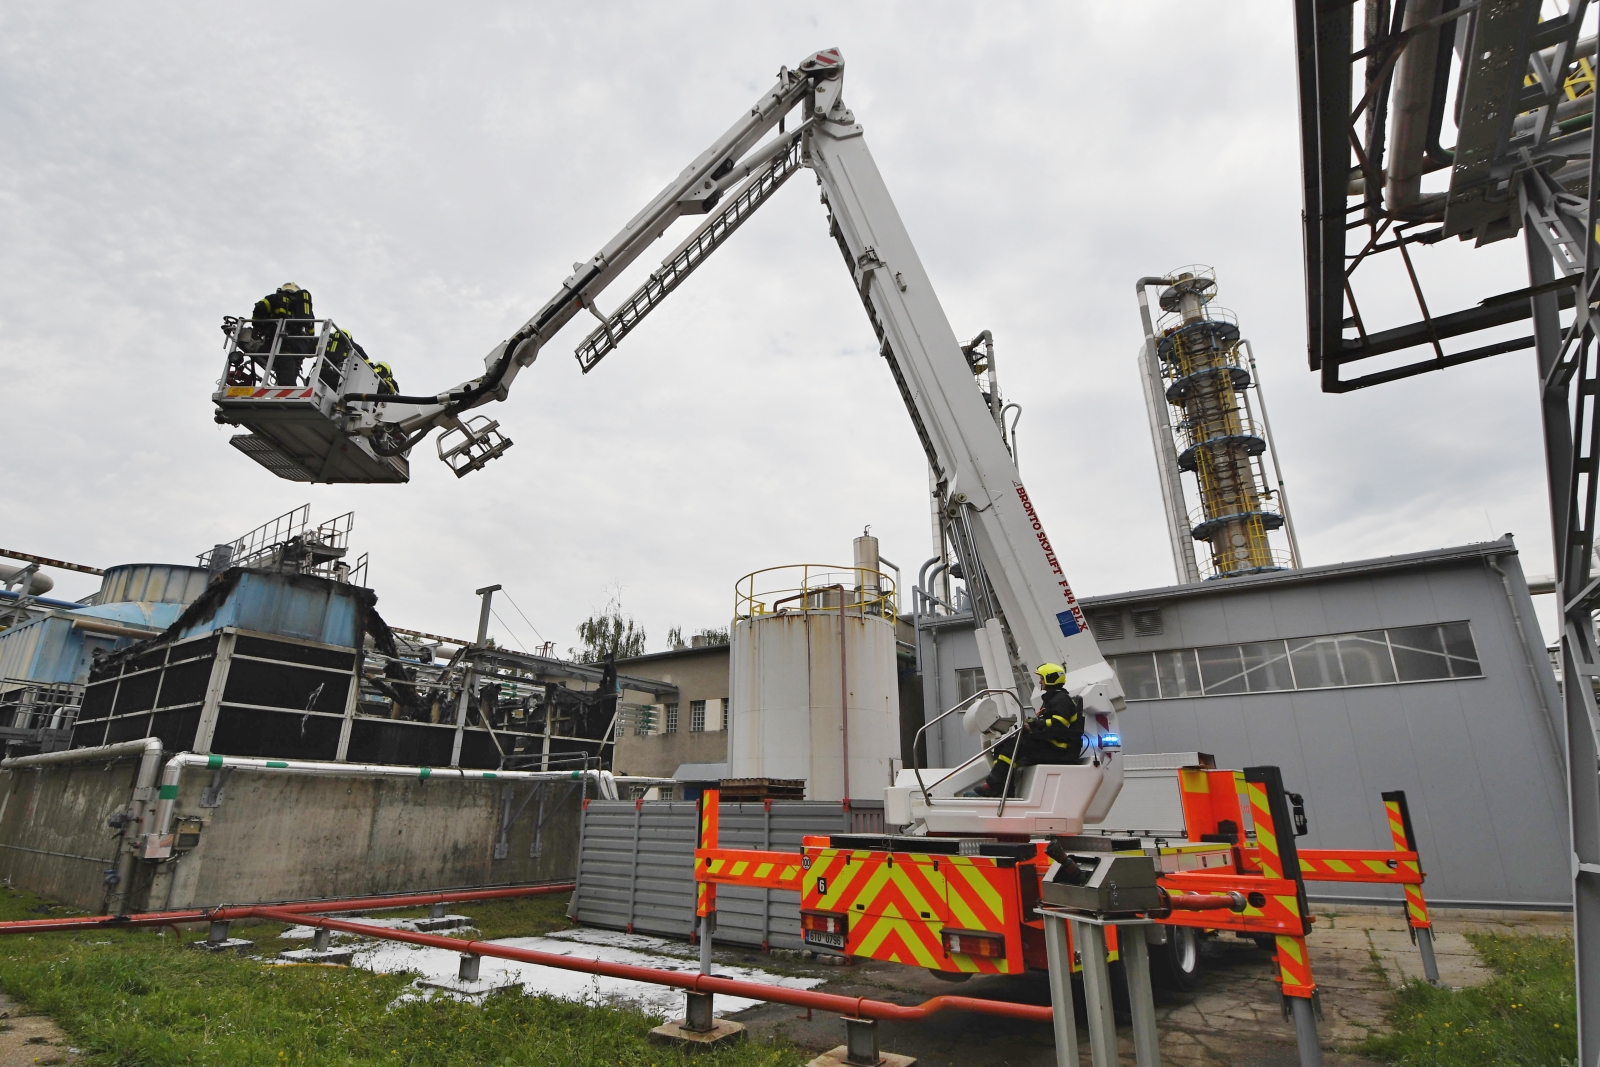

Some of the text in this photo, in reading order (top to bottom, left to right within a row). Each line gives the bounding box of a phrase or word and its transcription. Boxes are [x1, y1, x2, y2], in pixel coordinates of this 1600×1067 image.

[1016, 486, 1089, 633] BRONTO SKYLIFT F 44 RLX
[818, 879, 825, 893] 6
